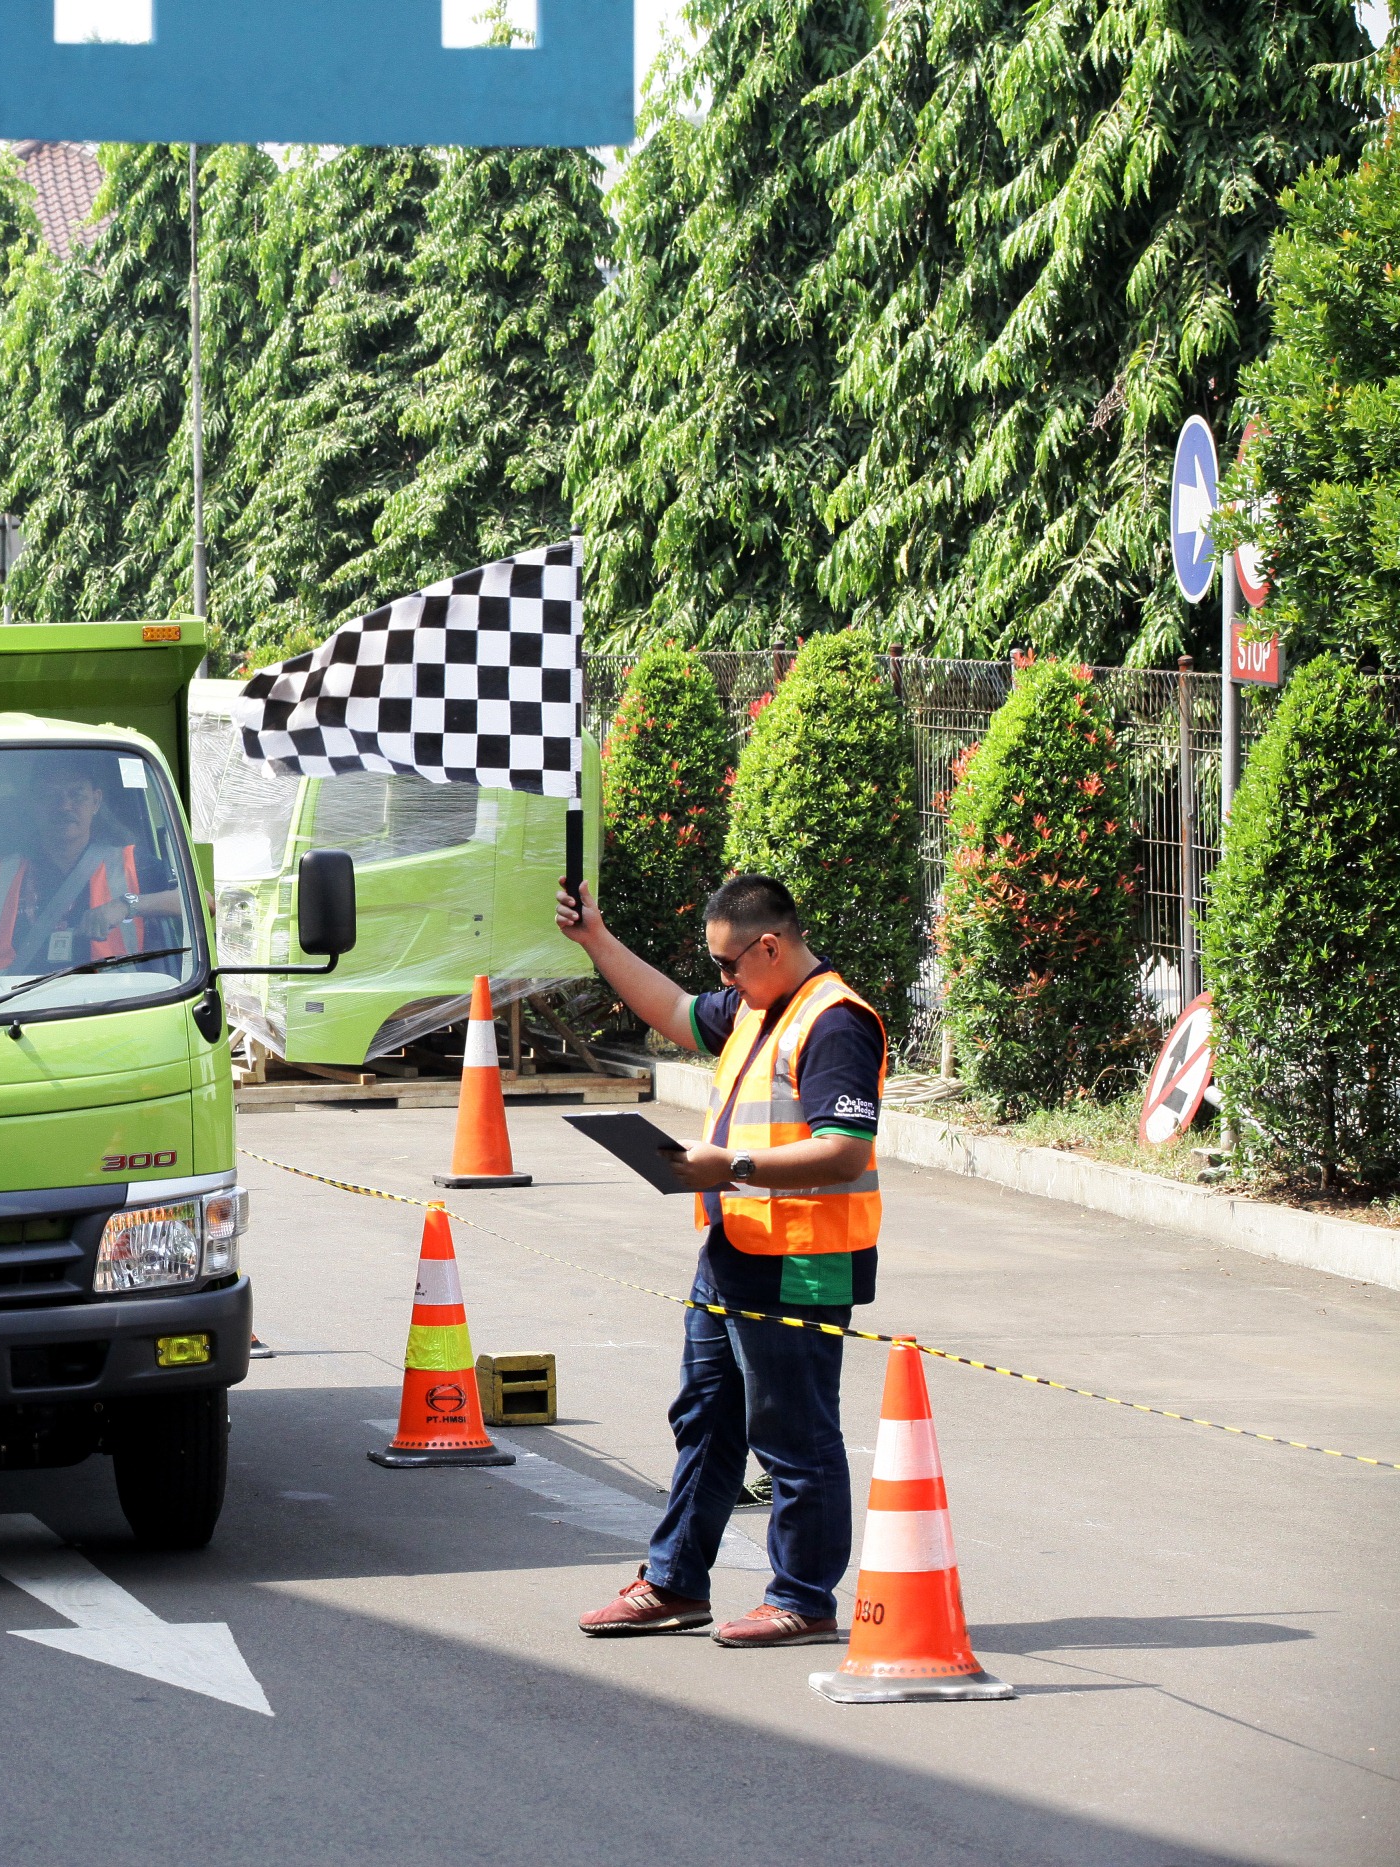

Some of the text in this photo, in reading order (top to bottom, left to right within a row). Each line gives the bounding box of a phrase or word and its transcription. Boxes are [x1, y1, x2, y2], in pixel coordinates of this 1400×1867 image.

[1237, 637, 1271, 672] STOP
[853, 1105, 875, 1117] Pledge
[101, 1150, 177, 1172] 300
